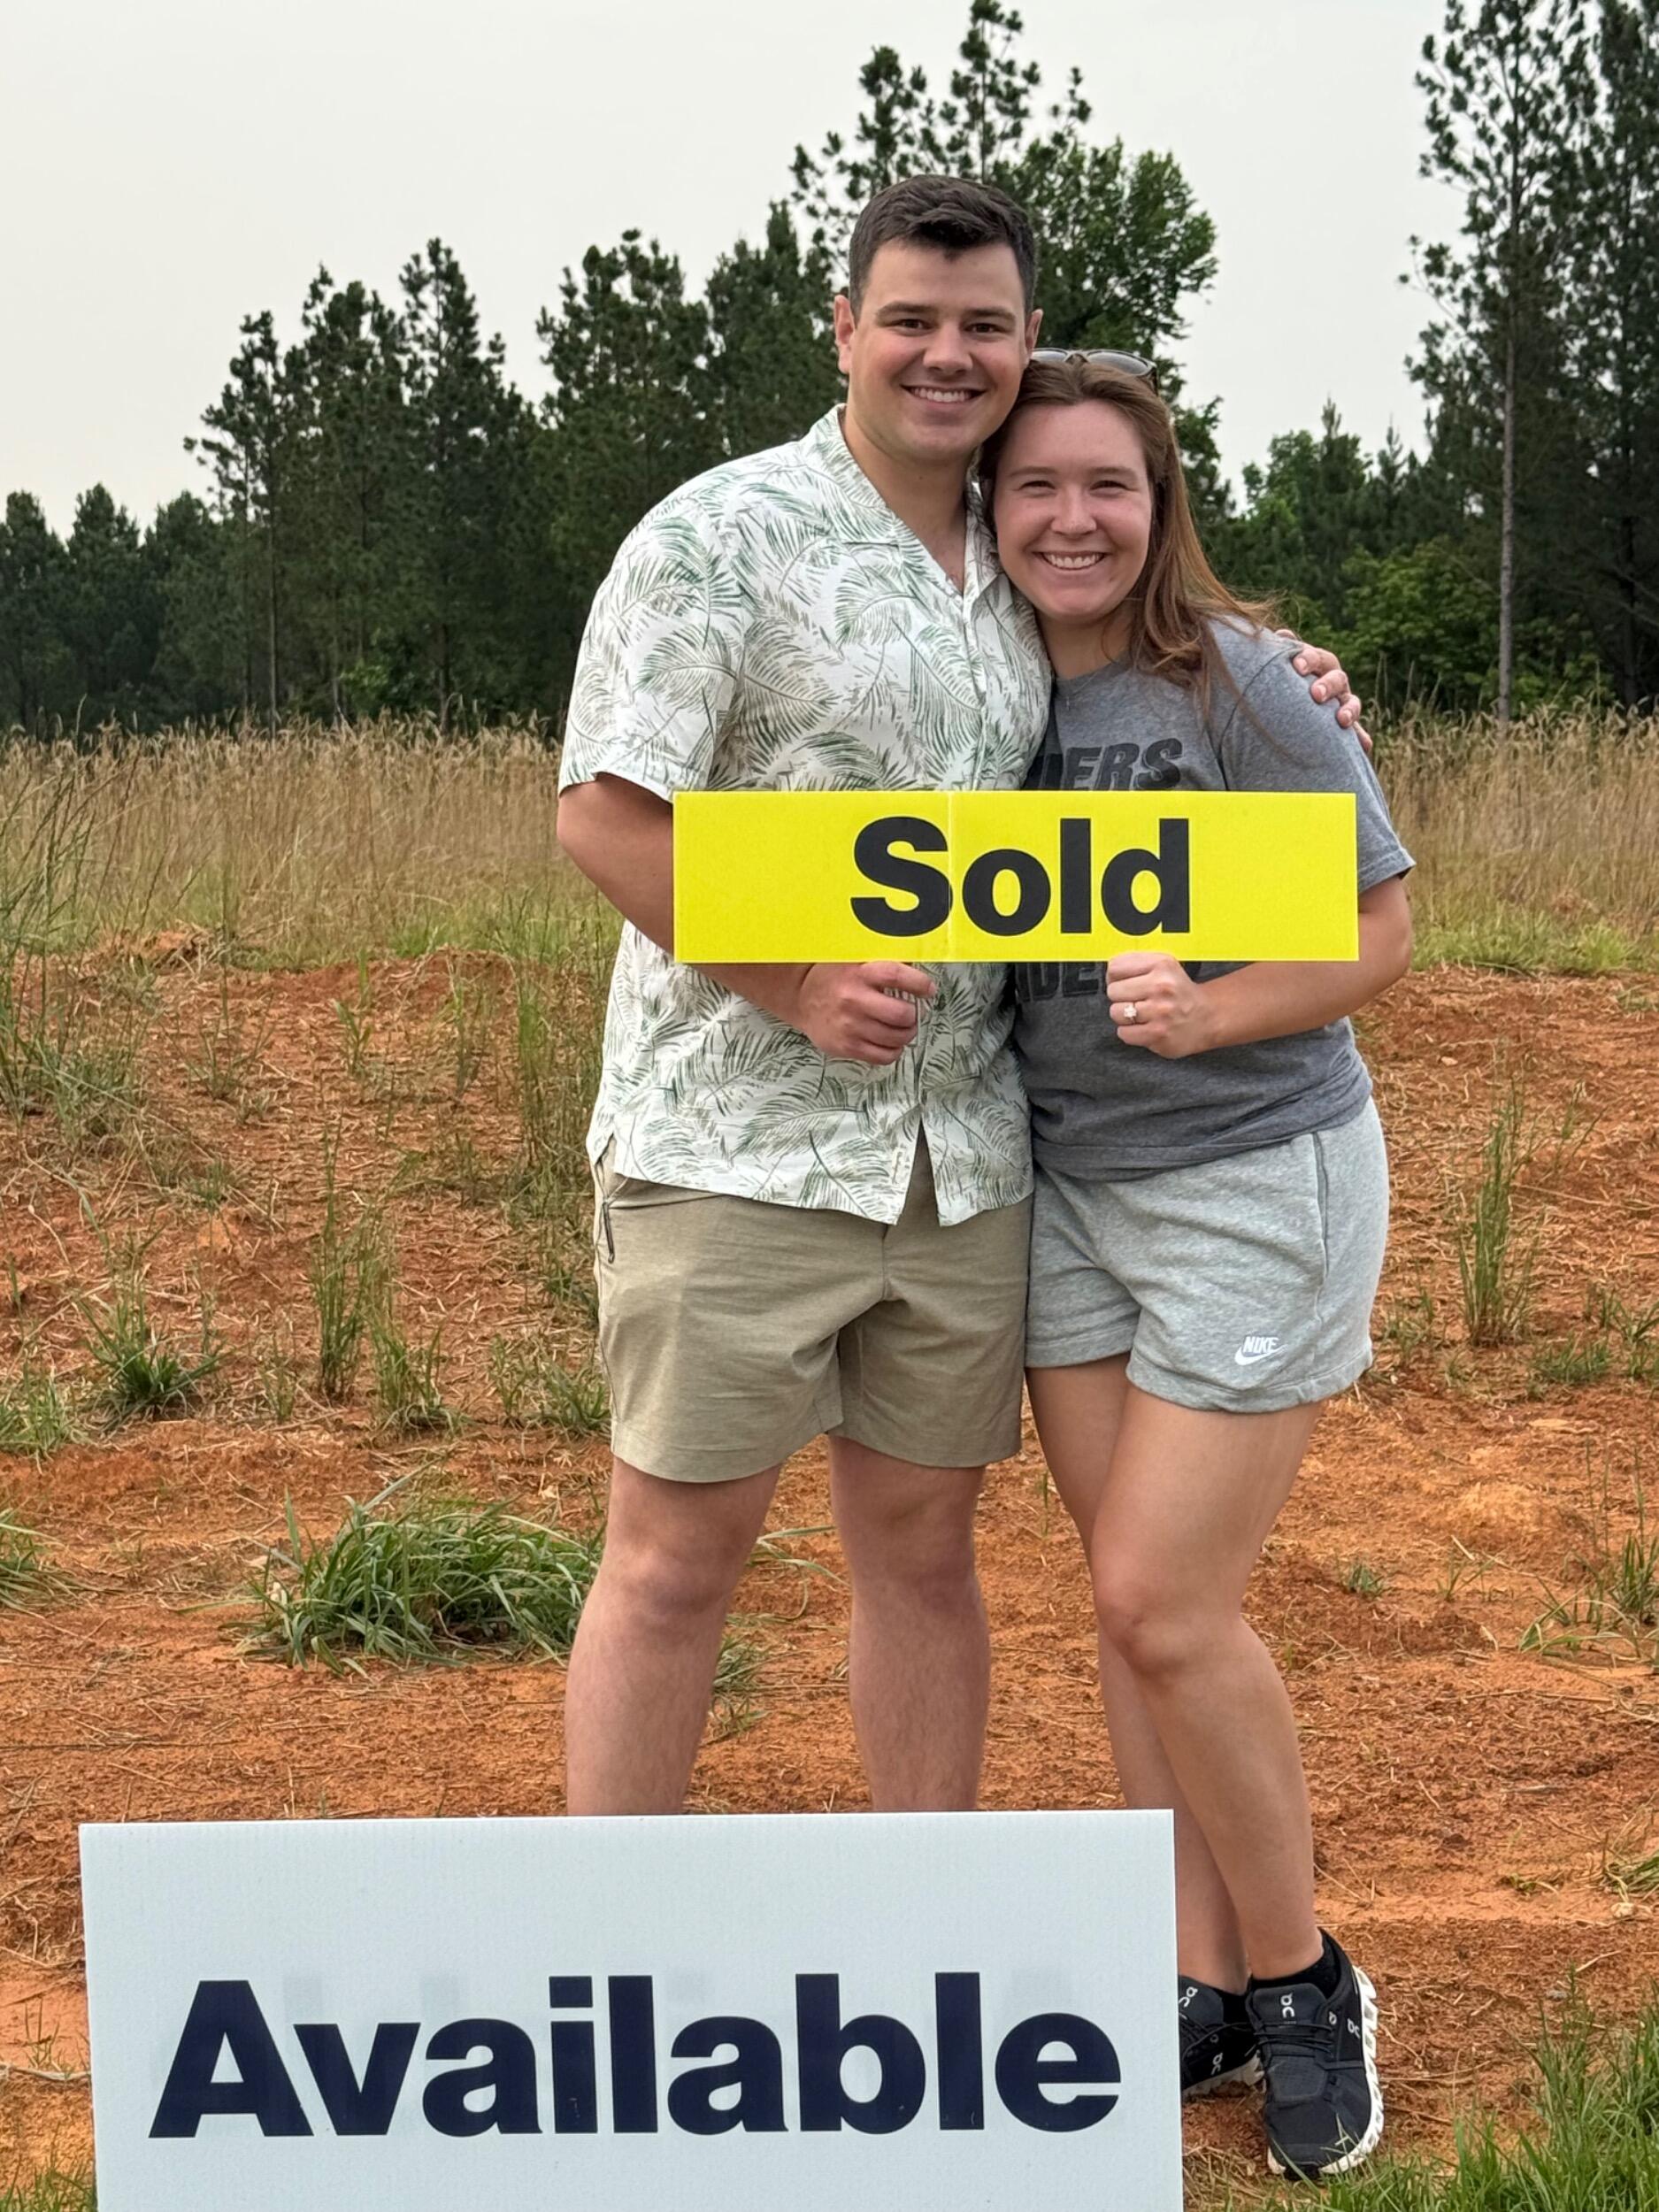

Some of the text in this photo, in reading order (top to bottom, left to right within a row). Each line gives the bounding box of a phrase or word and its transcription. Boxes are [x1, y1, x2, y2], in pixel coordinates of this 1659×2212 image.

[851, 817, 1189, 936] Sold
[1242, 1336, 1279, 1354] NIKE
[149, 1972, 1120, 2138] Available
